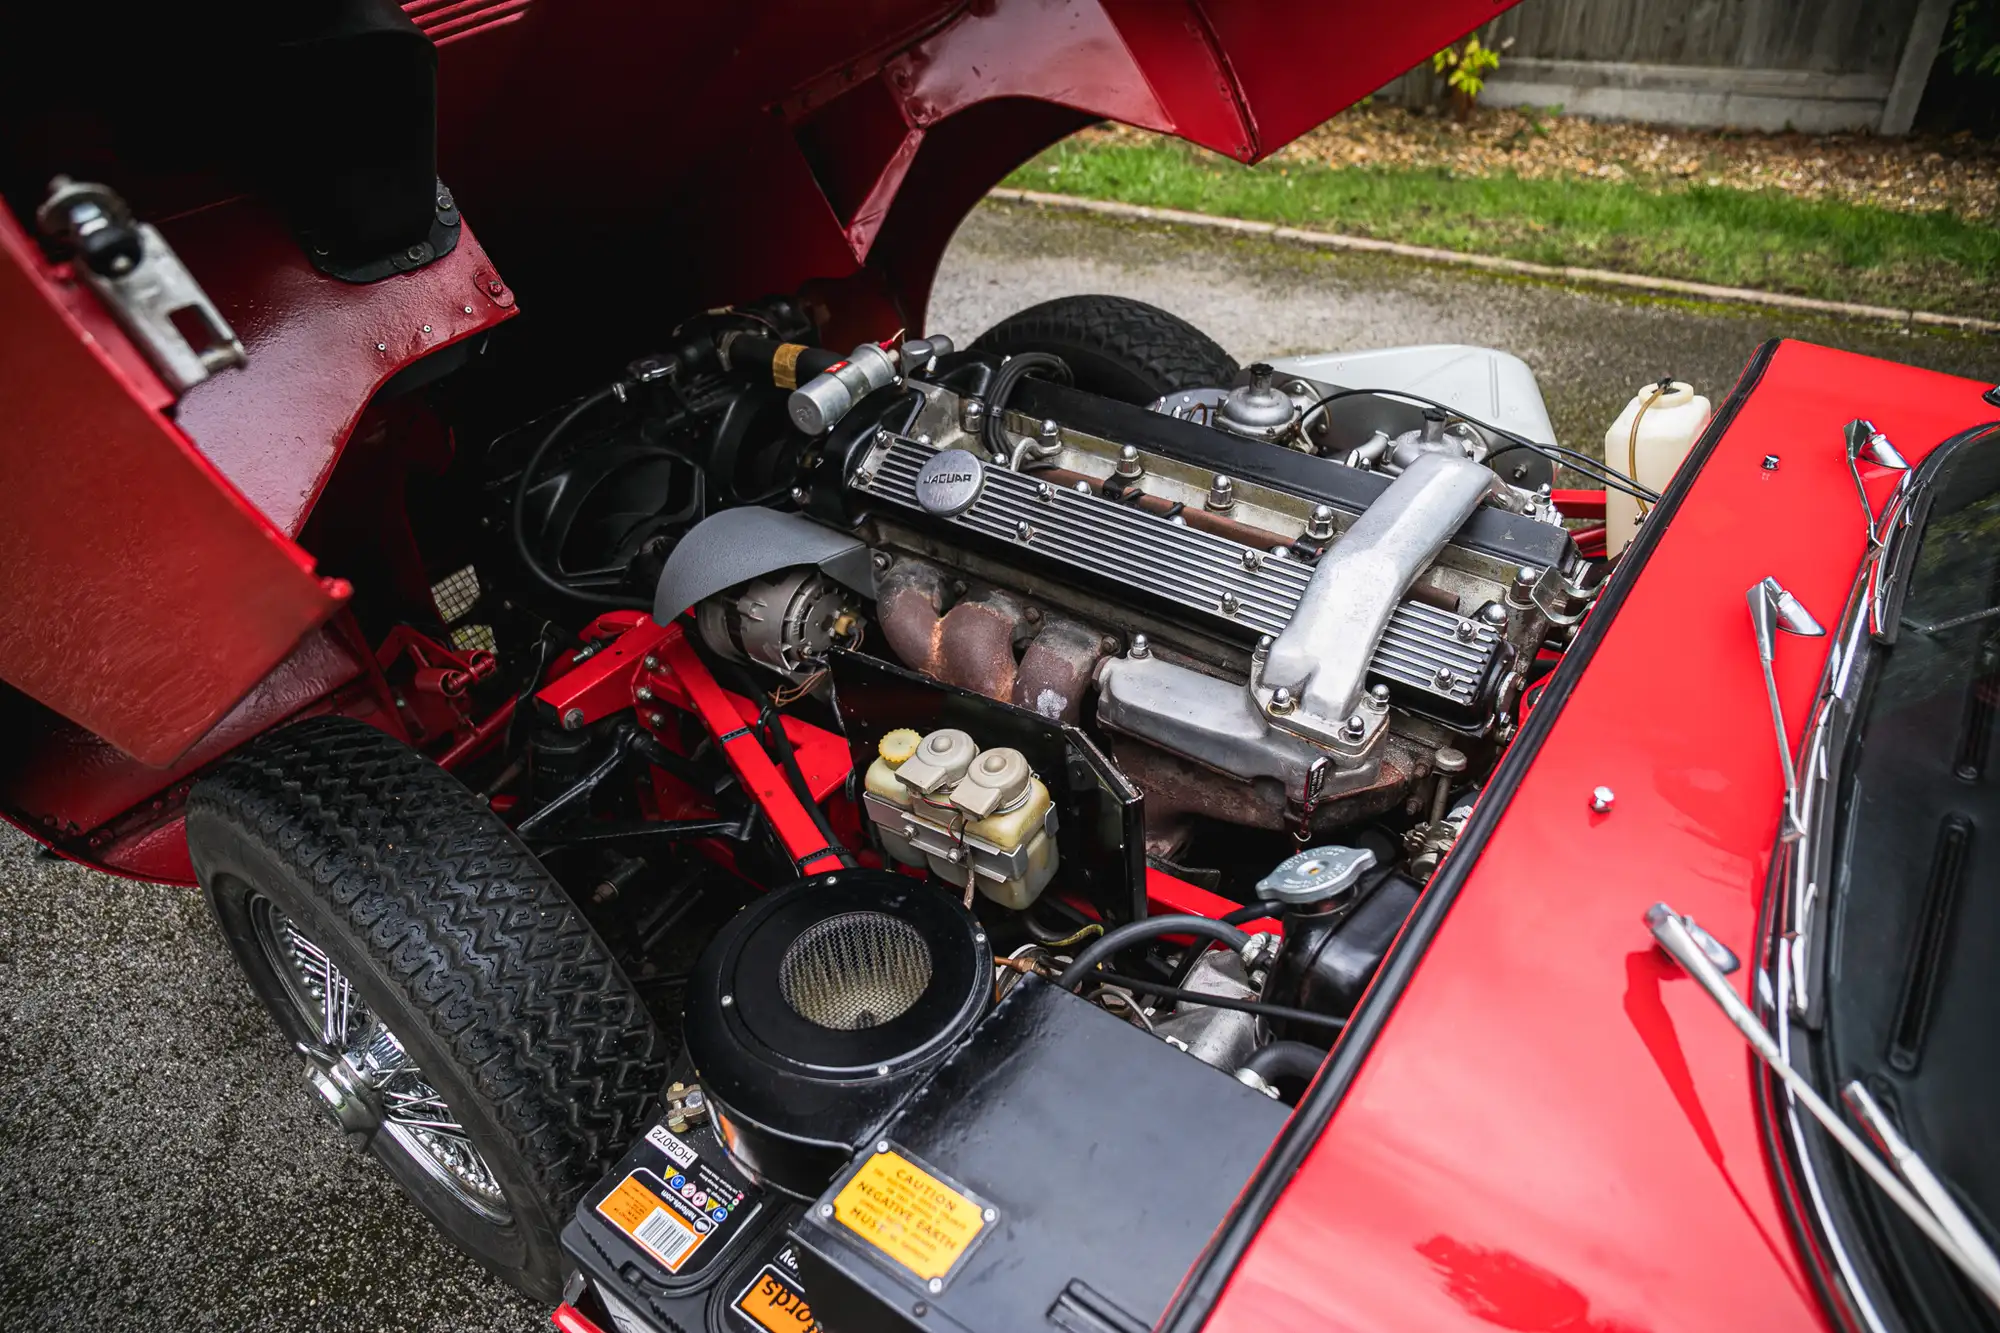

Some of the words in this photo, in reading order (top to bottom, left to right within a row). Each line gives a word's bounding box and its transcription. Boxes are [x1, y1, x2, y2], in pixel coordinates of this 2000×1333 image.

[923, 473, 973, 485] JAGUAR
[651, 1128, 693, 1163] HCB072
[660, 1189, 697, 1221] halfords.com
[896, 1168, 957, 1212] CAUTION
[850, 1206, 887, 1235] MUST
[857, 1181, 914, 1222] NEGATIVE
[915, 1219, 958, 1250] EARTH
